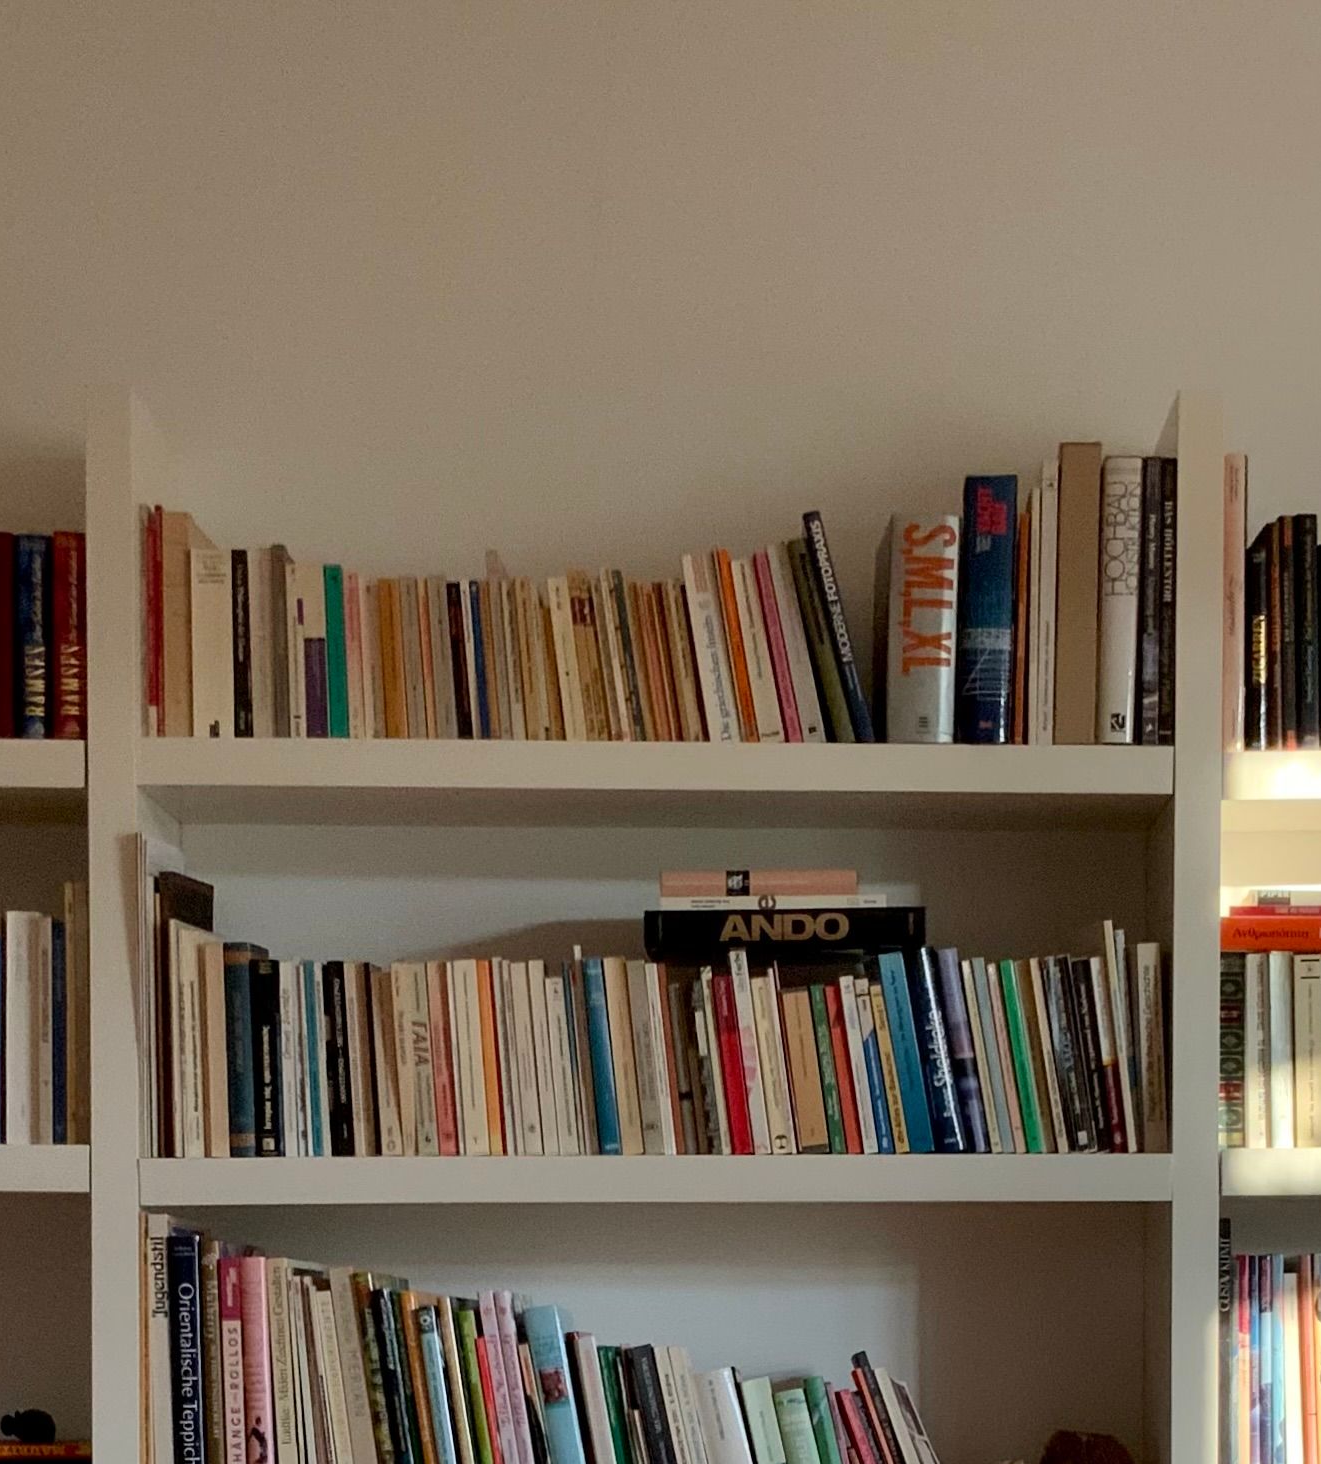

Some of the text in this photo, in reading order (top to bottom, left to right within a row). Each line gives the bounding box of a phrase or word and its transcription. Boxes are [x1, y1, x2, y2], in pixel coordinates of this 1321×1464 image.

[1106, 481, 1128, 597] HOCHBAU
[809, 519, 855, 663] MODERNE FOTOPRAXIS
[23, 644, 46, 717] RAMSES
[59, 643, 83, 716] RAMSES
[721, 913, 851, 941] ANDO
[411, 1021, 429, 1067] ΓΑΙΑ
[925, 1009, 953, 1087] Sheldrake
[151, 1236, 169, 1318] Jugendstil
[177, 1282, 197, 1397] Orientalische
